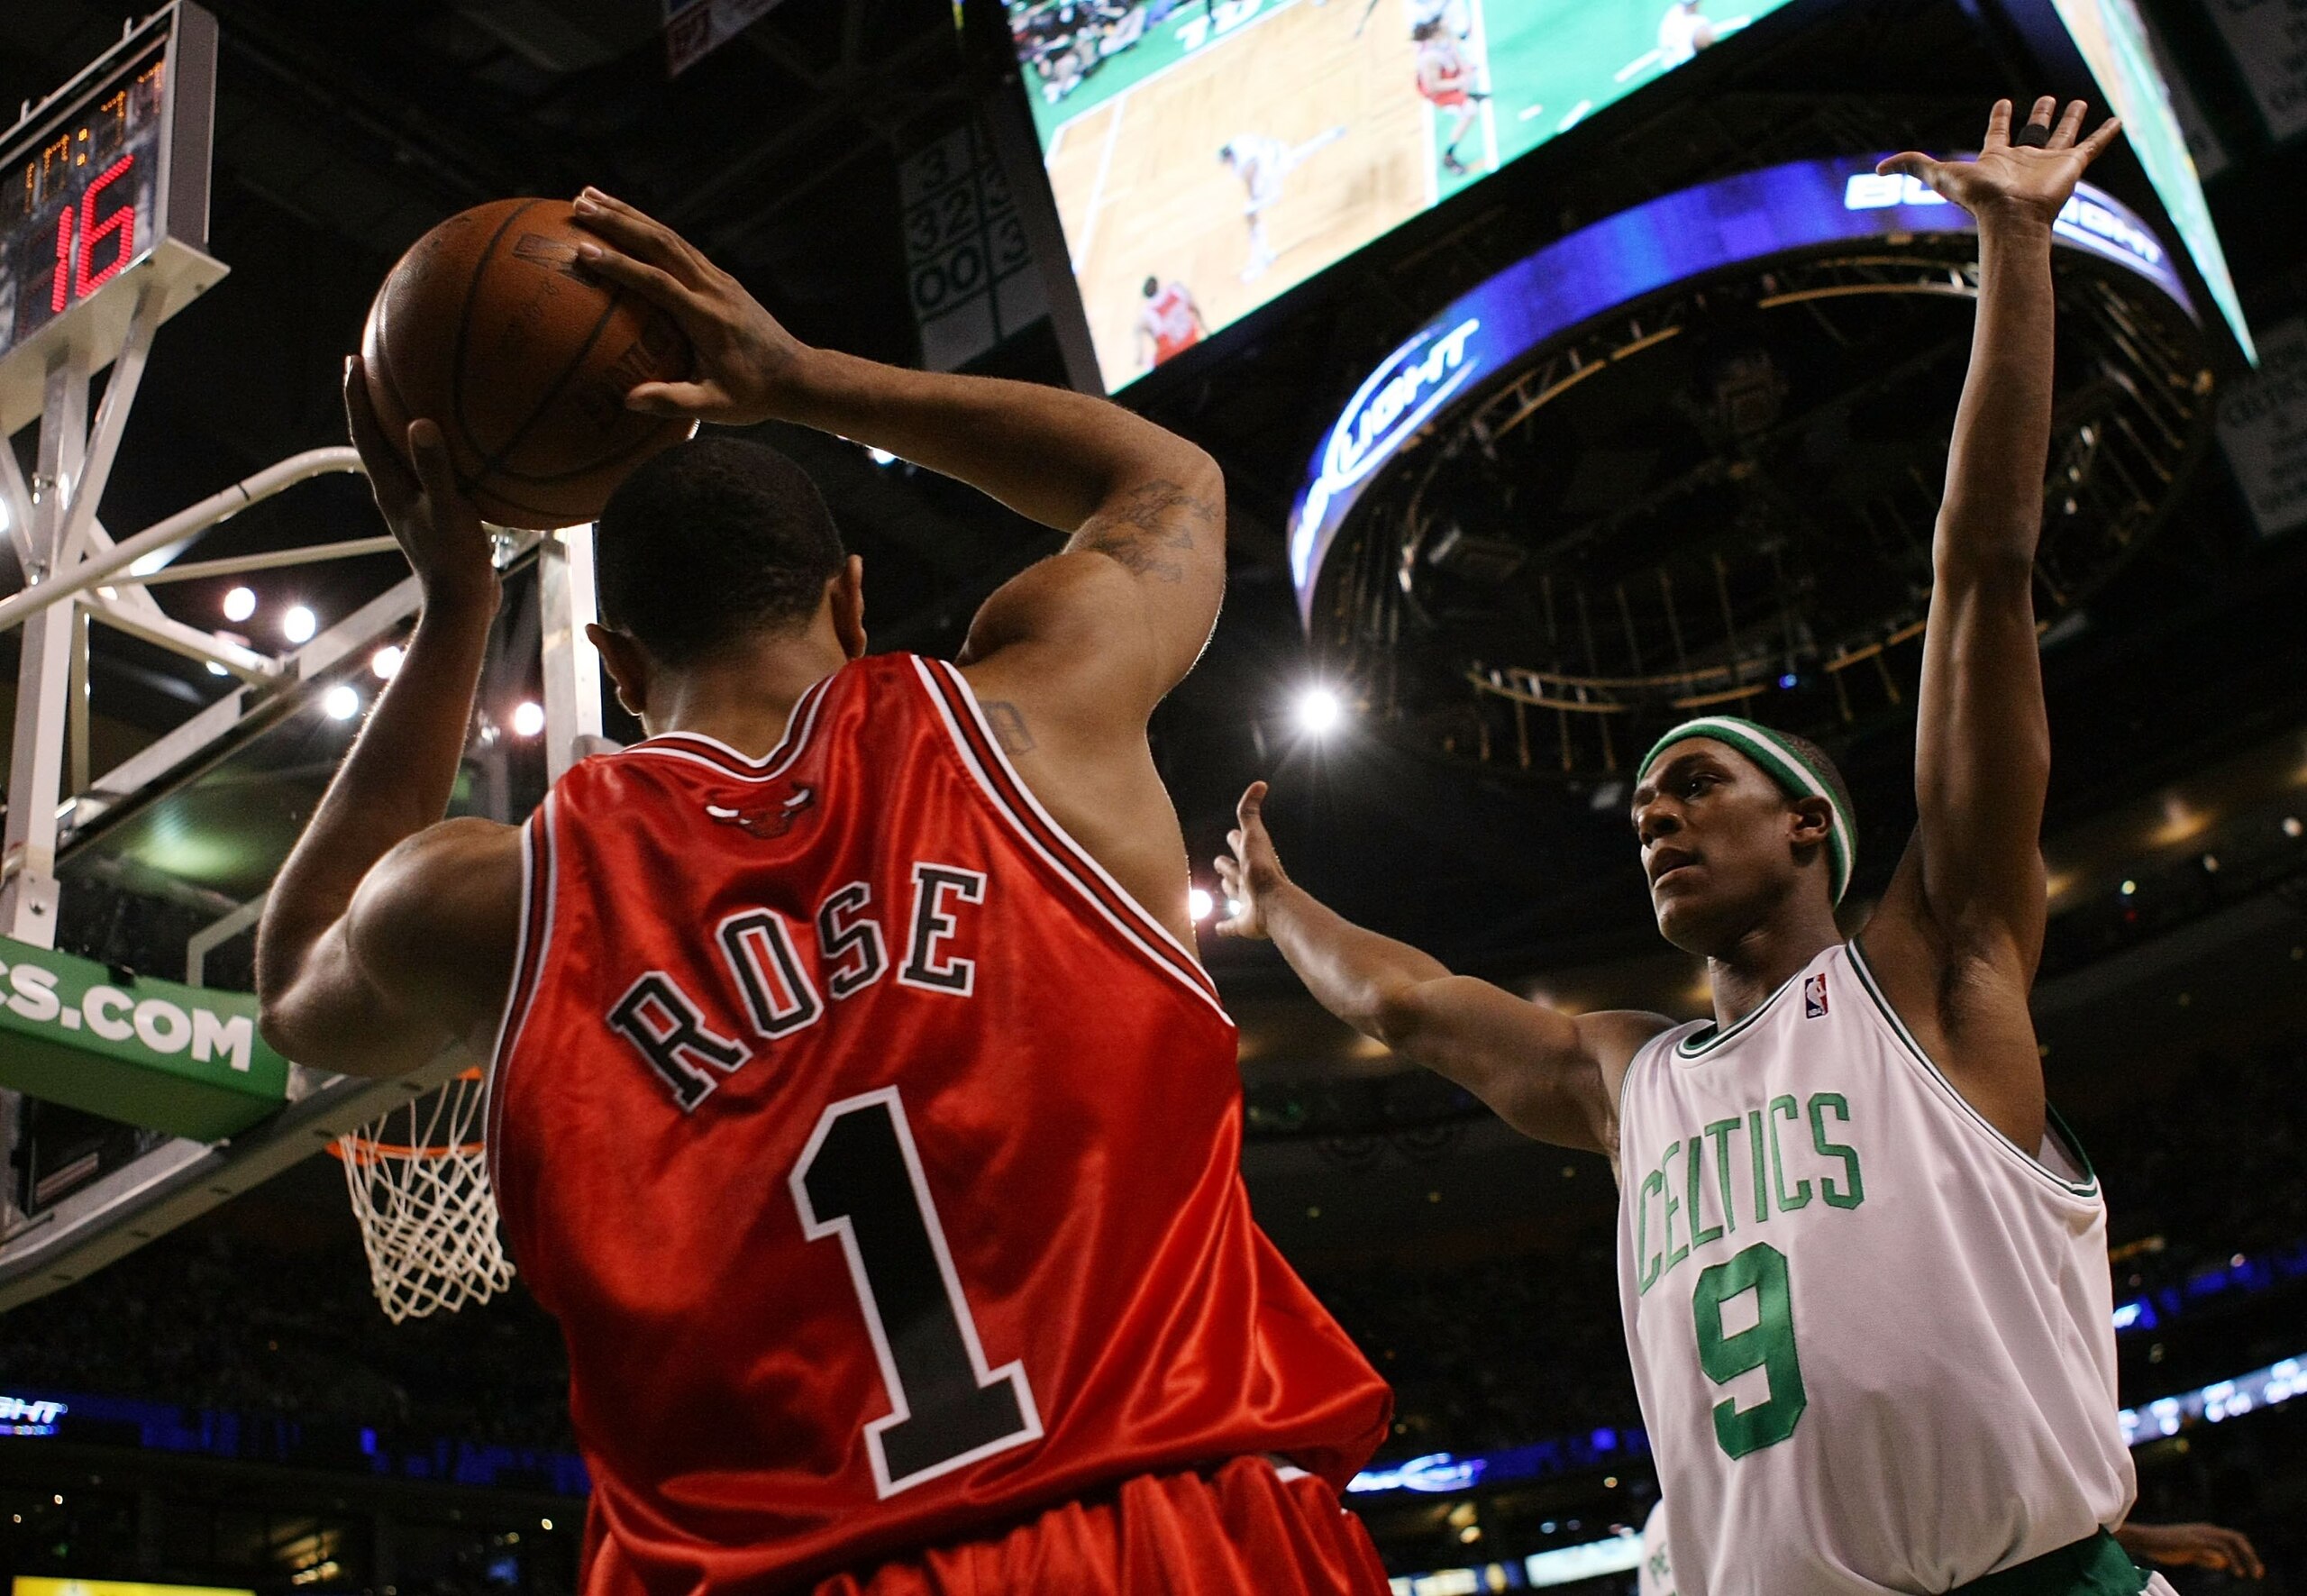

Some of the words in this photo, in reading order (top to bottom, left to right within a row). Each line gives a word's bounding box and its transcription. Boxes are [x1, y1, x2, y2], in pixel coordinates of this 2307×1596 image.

[50, 153, 135, 313] 16
[910, 188, 973, 253] 32
[1337, 317, 1481, 475] LIGHT
[606, 861, 989, 1115] ROSE
[788, 1083, 1045, 1501] 1
[1637, 1092, 1865, 1297] CELTICS
[1691, 1241, 1807, 1461] 9
